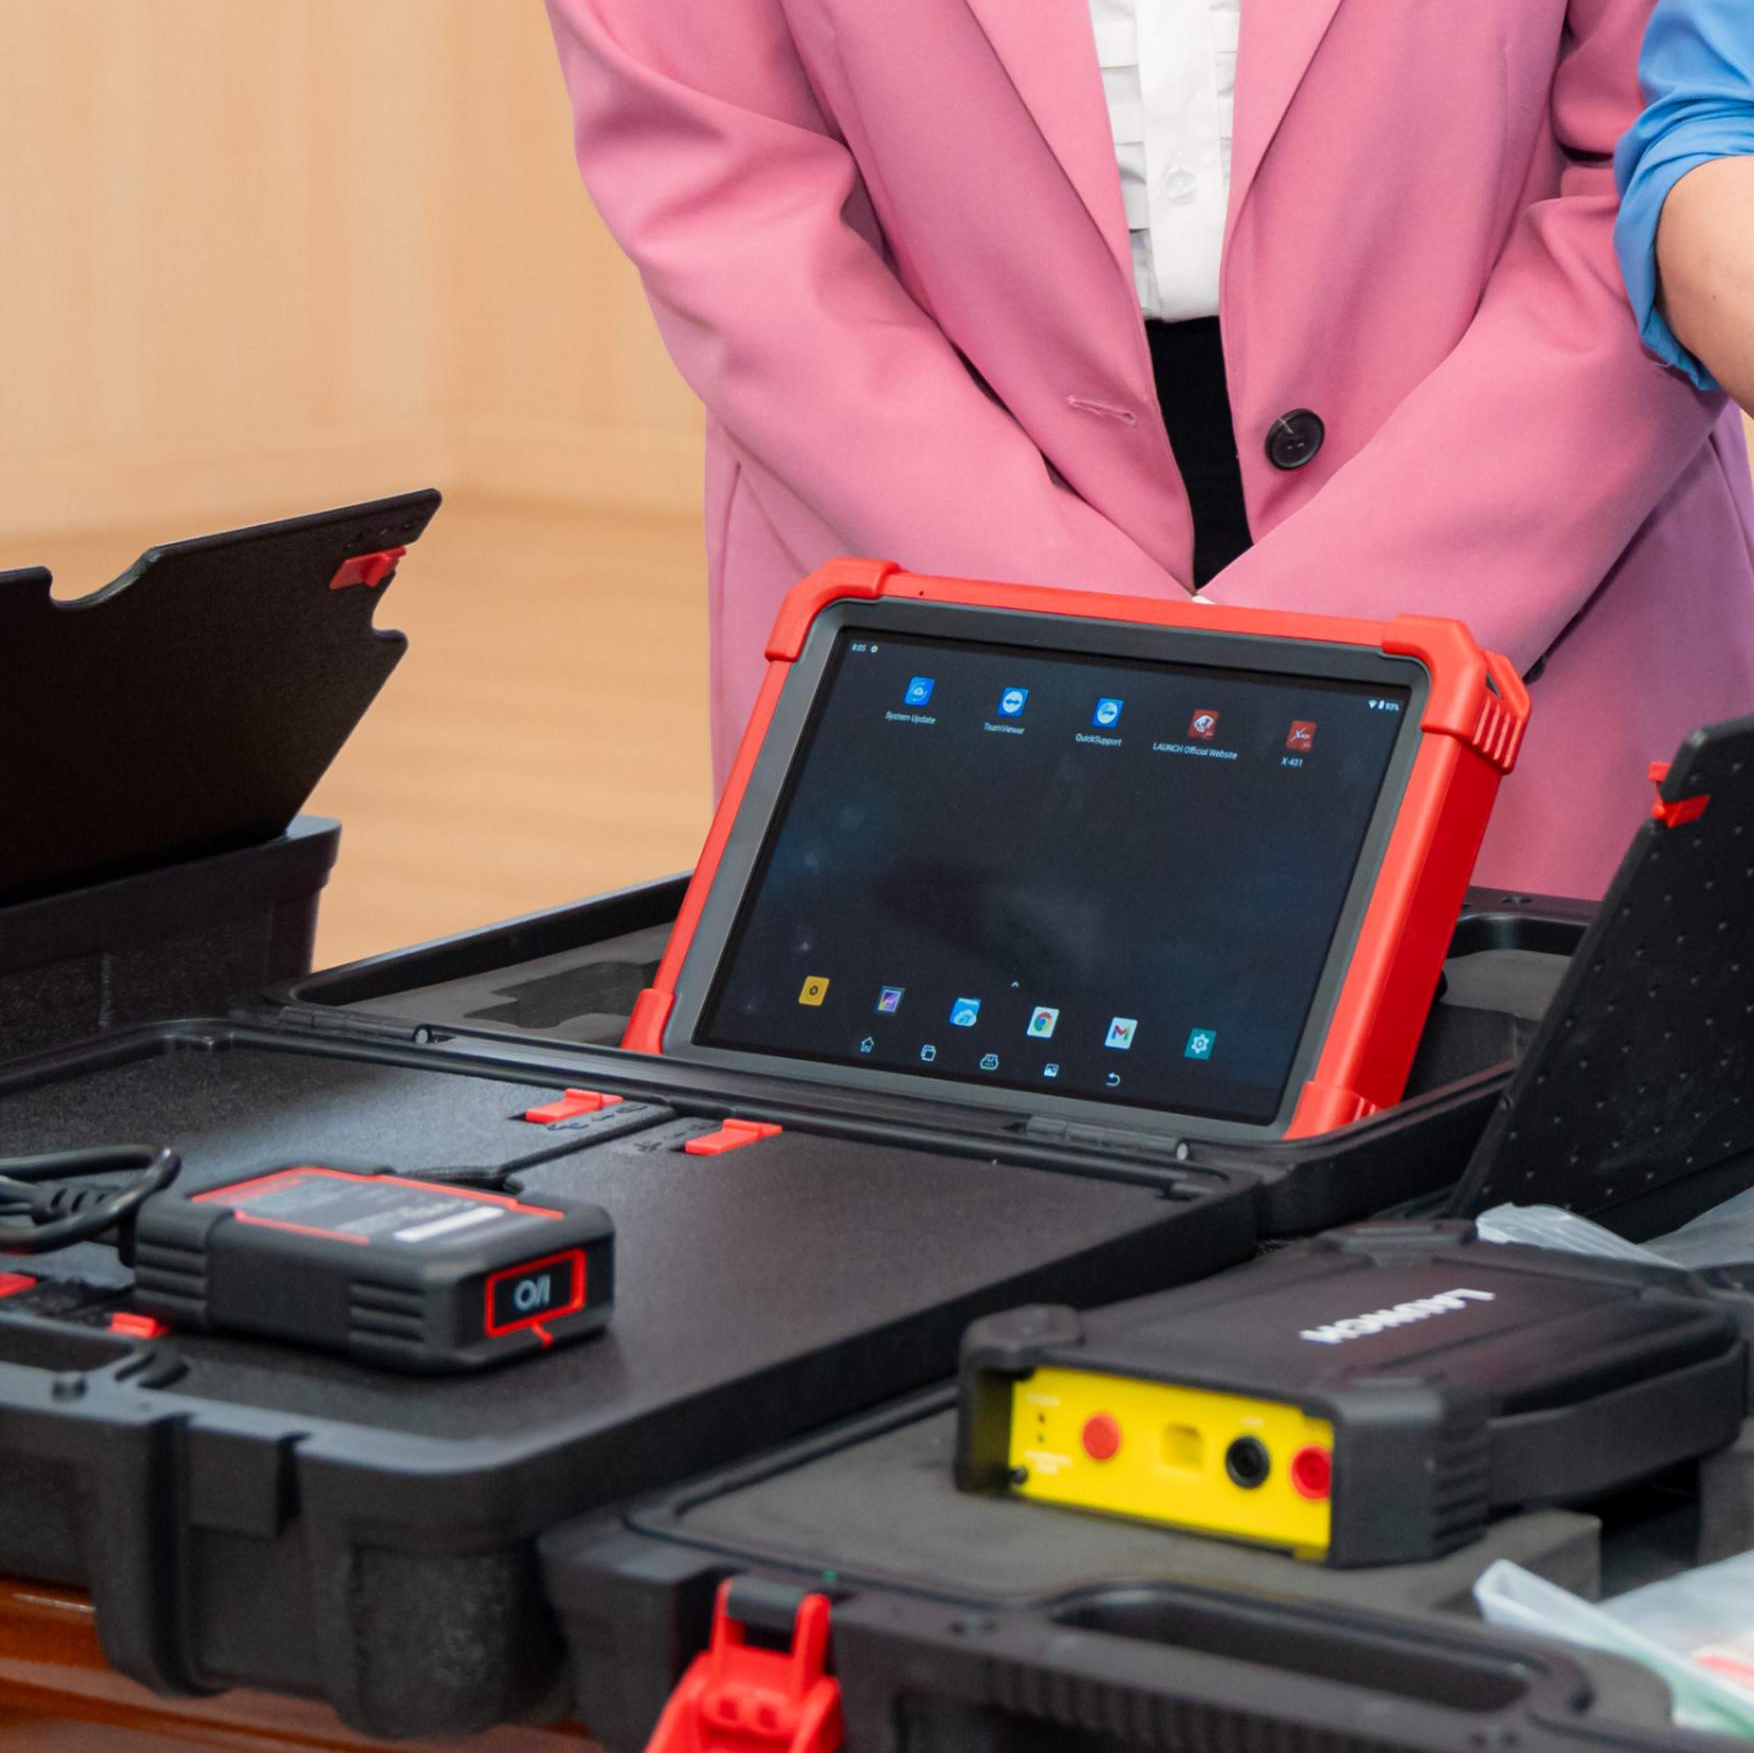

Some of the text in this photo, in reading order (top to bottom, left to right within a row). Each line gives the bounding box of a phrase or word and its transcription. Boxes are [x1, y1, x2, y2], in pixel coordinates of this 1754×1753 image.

[984, 722, 1025, 735] TeamViewer
[1075, 732, 1122, 747] QuickSupport
[1152, 741, 1184, 754] LAUNCH
[1209, 748, 1238, 760] Website
